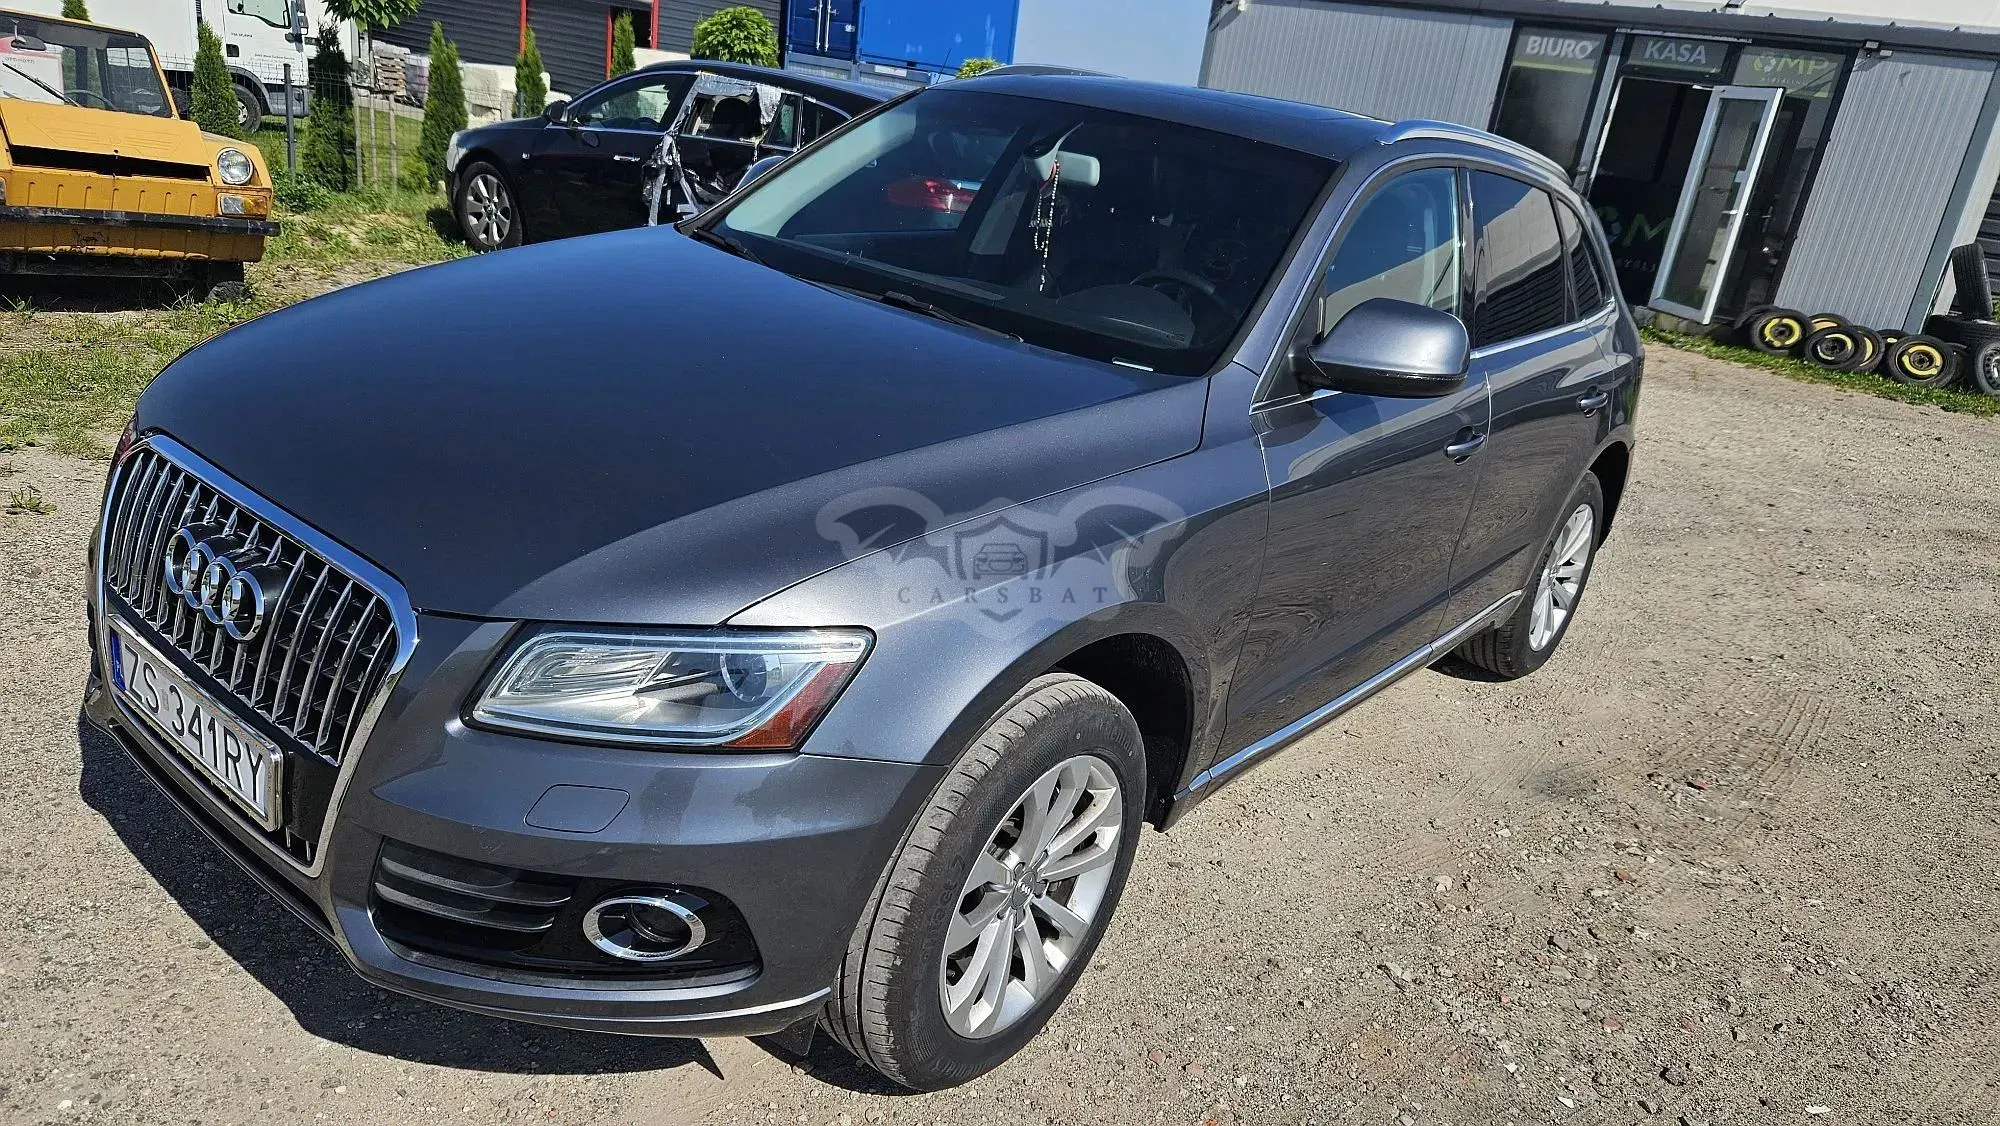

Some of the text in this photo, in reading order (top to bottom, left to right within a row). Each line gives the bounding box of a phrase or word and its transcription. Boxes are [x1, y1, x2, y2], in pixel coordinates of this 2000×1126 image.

[1526, 35, 1593, 60] BIURO
[1644, 40, 1706, 64] KASA
[124, 643, 263, 804] ZS 341RY
